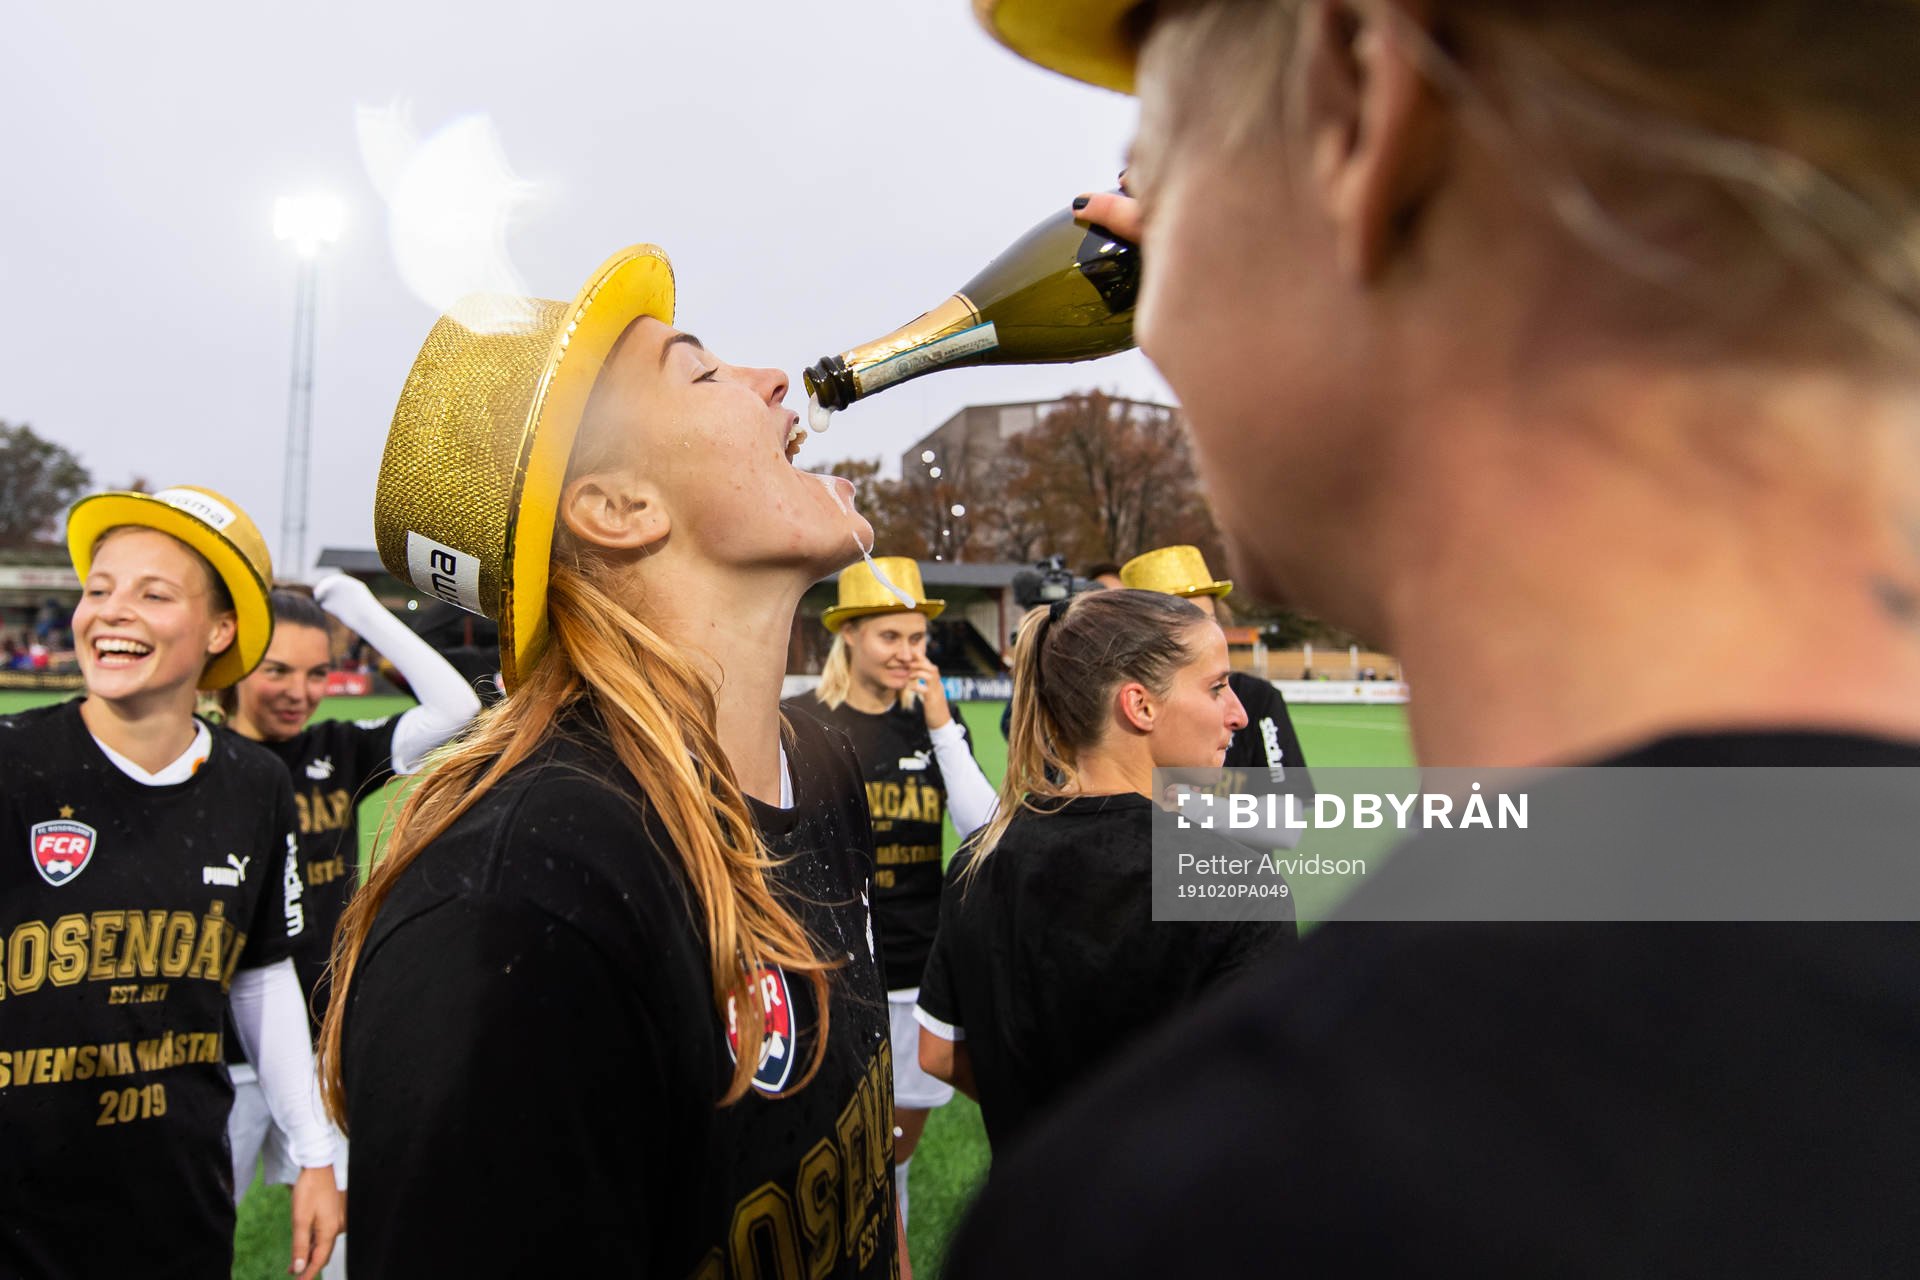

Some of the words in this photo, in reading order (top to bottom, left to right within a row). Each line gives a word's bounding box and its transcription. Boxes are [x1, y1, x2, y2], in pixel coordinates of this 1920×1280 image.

[430, 549, 461, 605] ma
[39, 836, 86, 854] FCR
[96, 1083, 168, 1126] 2019
